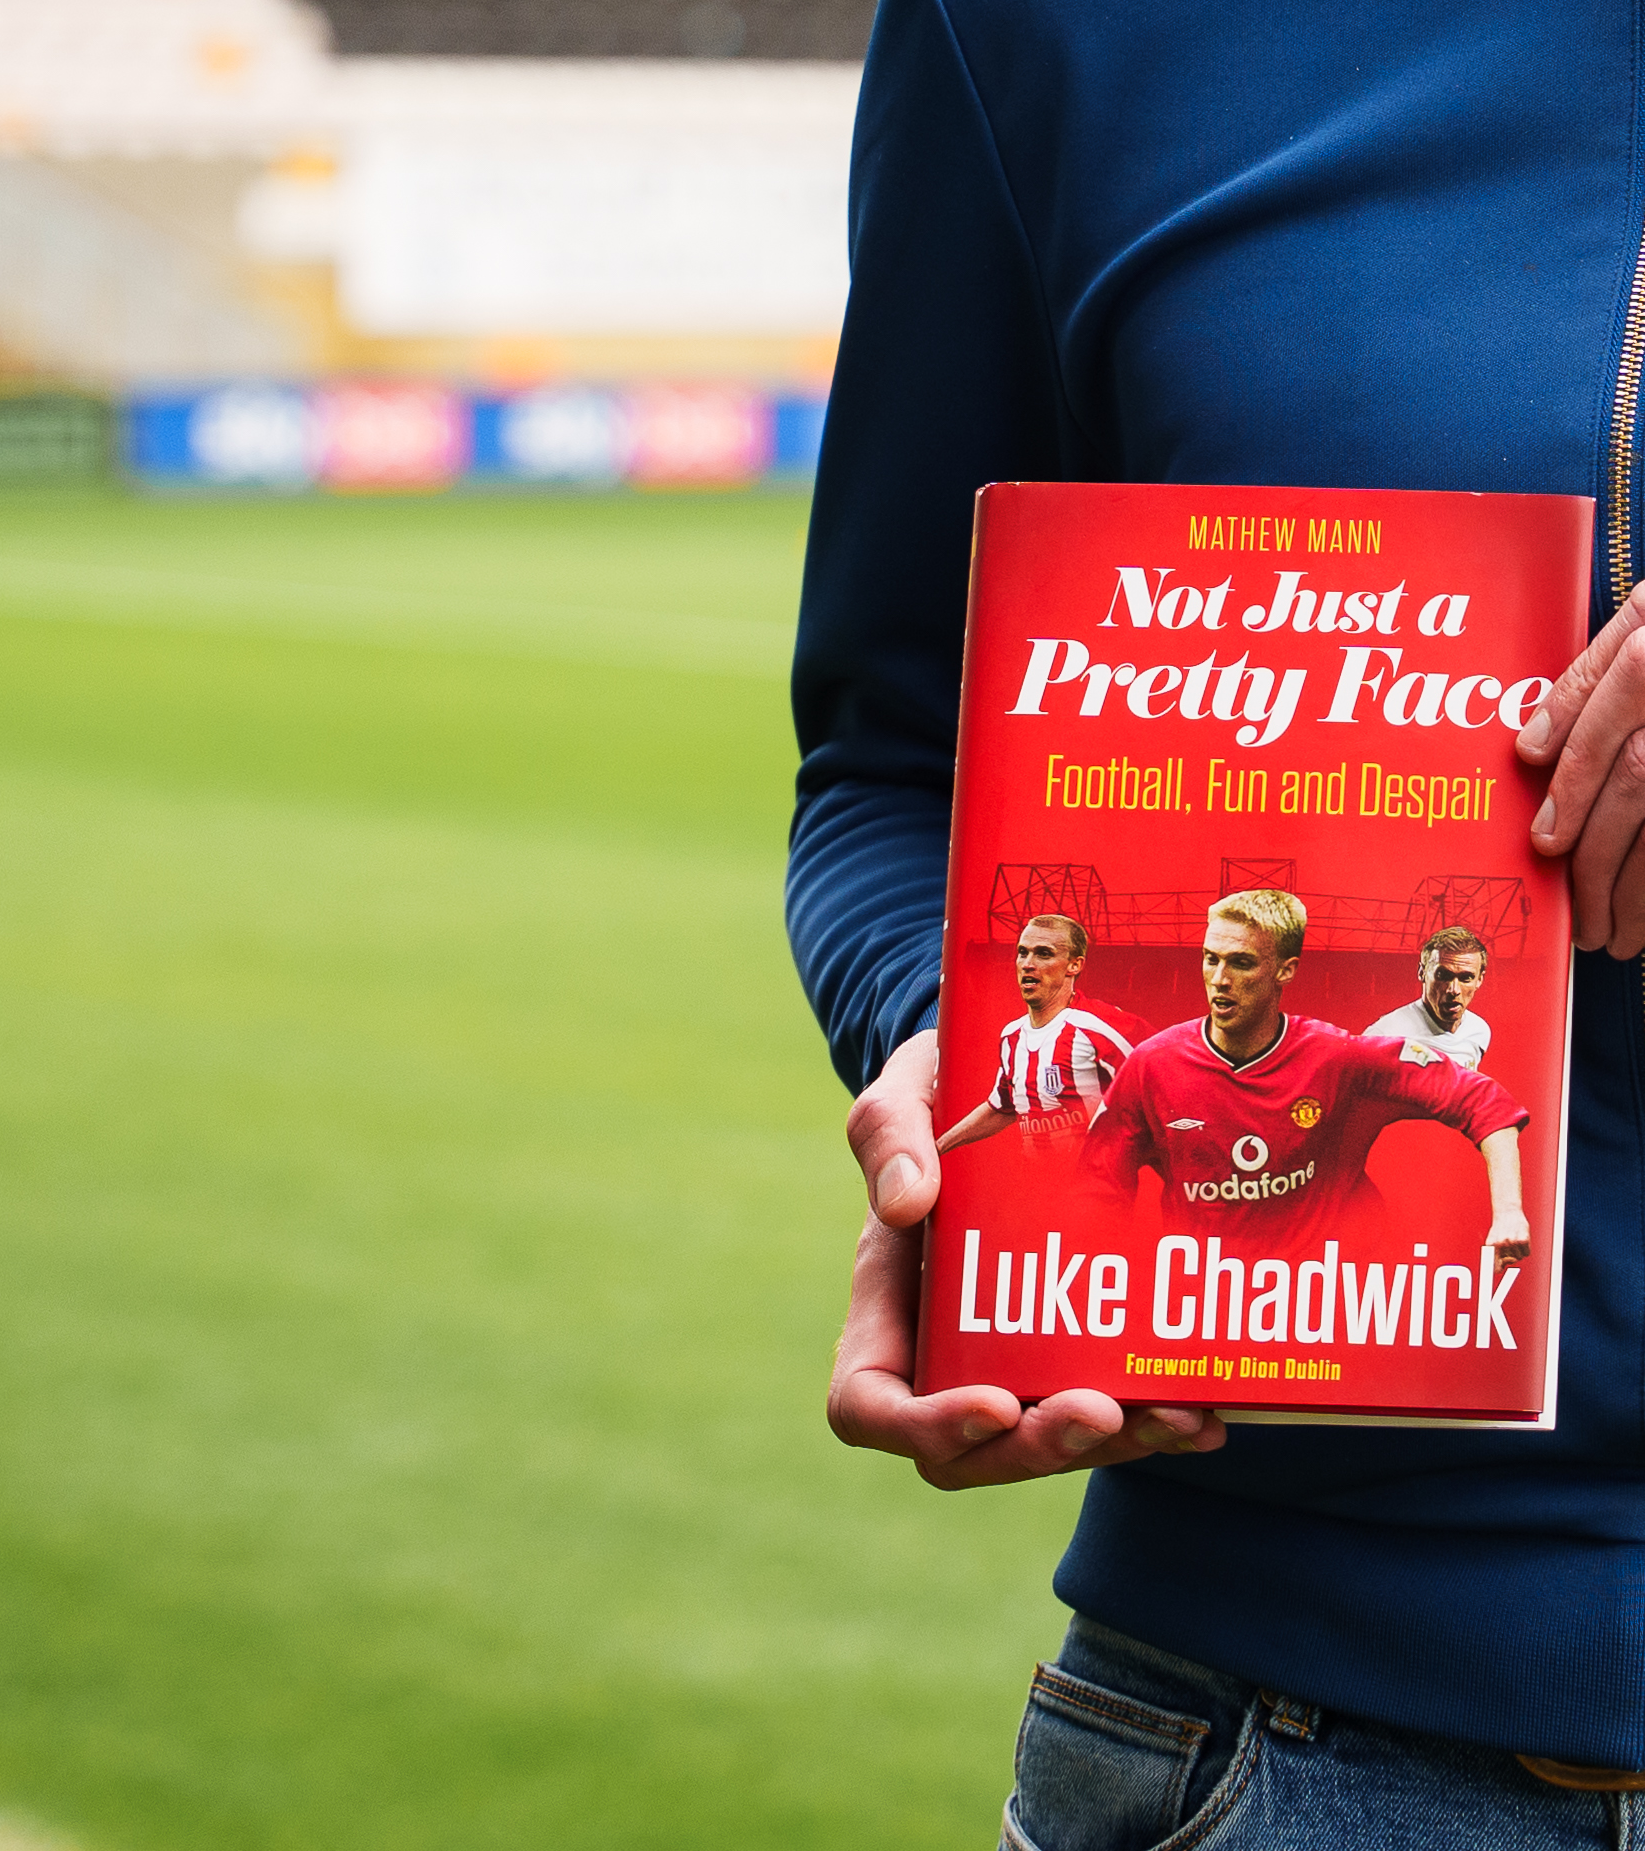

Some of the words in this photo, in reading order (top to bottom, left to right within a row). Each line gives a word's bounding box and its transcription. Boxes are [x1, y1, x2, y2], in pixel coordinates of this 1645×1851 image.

[1189, 516, 1296, 552] MATHEW
[1307, 518, 1382, 554] MANN
[1097, 566, 1236, 631] Not
[1242, 571, 1409, 636] Just
[1417, 593, 1471, 637] a
[1004, 638, 1305, 748] Pretty
[1316, 646, 1554, 731] Face
[1045, 754, 1192, 815] Football,
[1206, 758, 1268, 813] Fun
[1279, 761, 1347, 816] and
[1359, 762, 1497, 829] Despair
[1183, 1159, 1315, 1202] vodafone
[958, 1229, 1129, 1338] Luke
[1152, 1234, 1518, 1350] Chadwick
[1125, 1353, 1208, 1377] Foreword
[1213, 1356, 1235, 1381] by
[1239, 1357, 1279, 1379] Dion
[1284, 1358, 1342, 1381] Dublin
